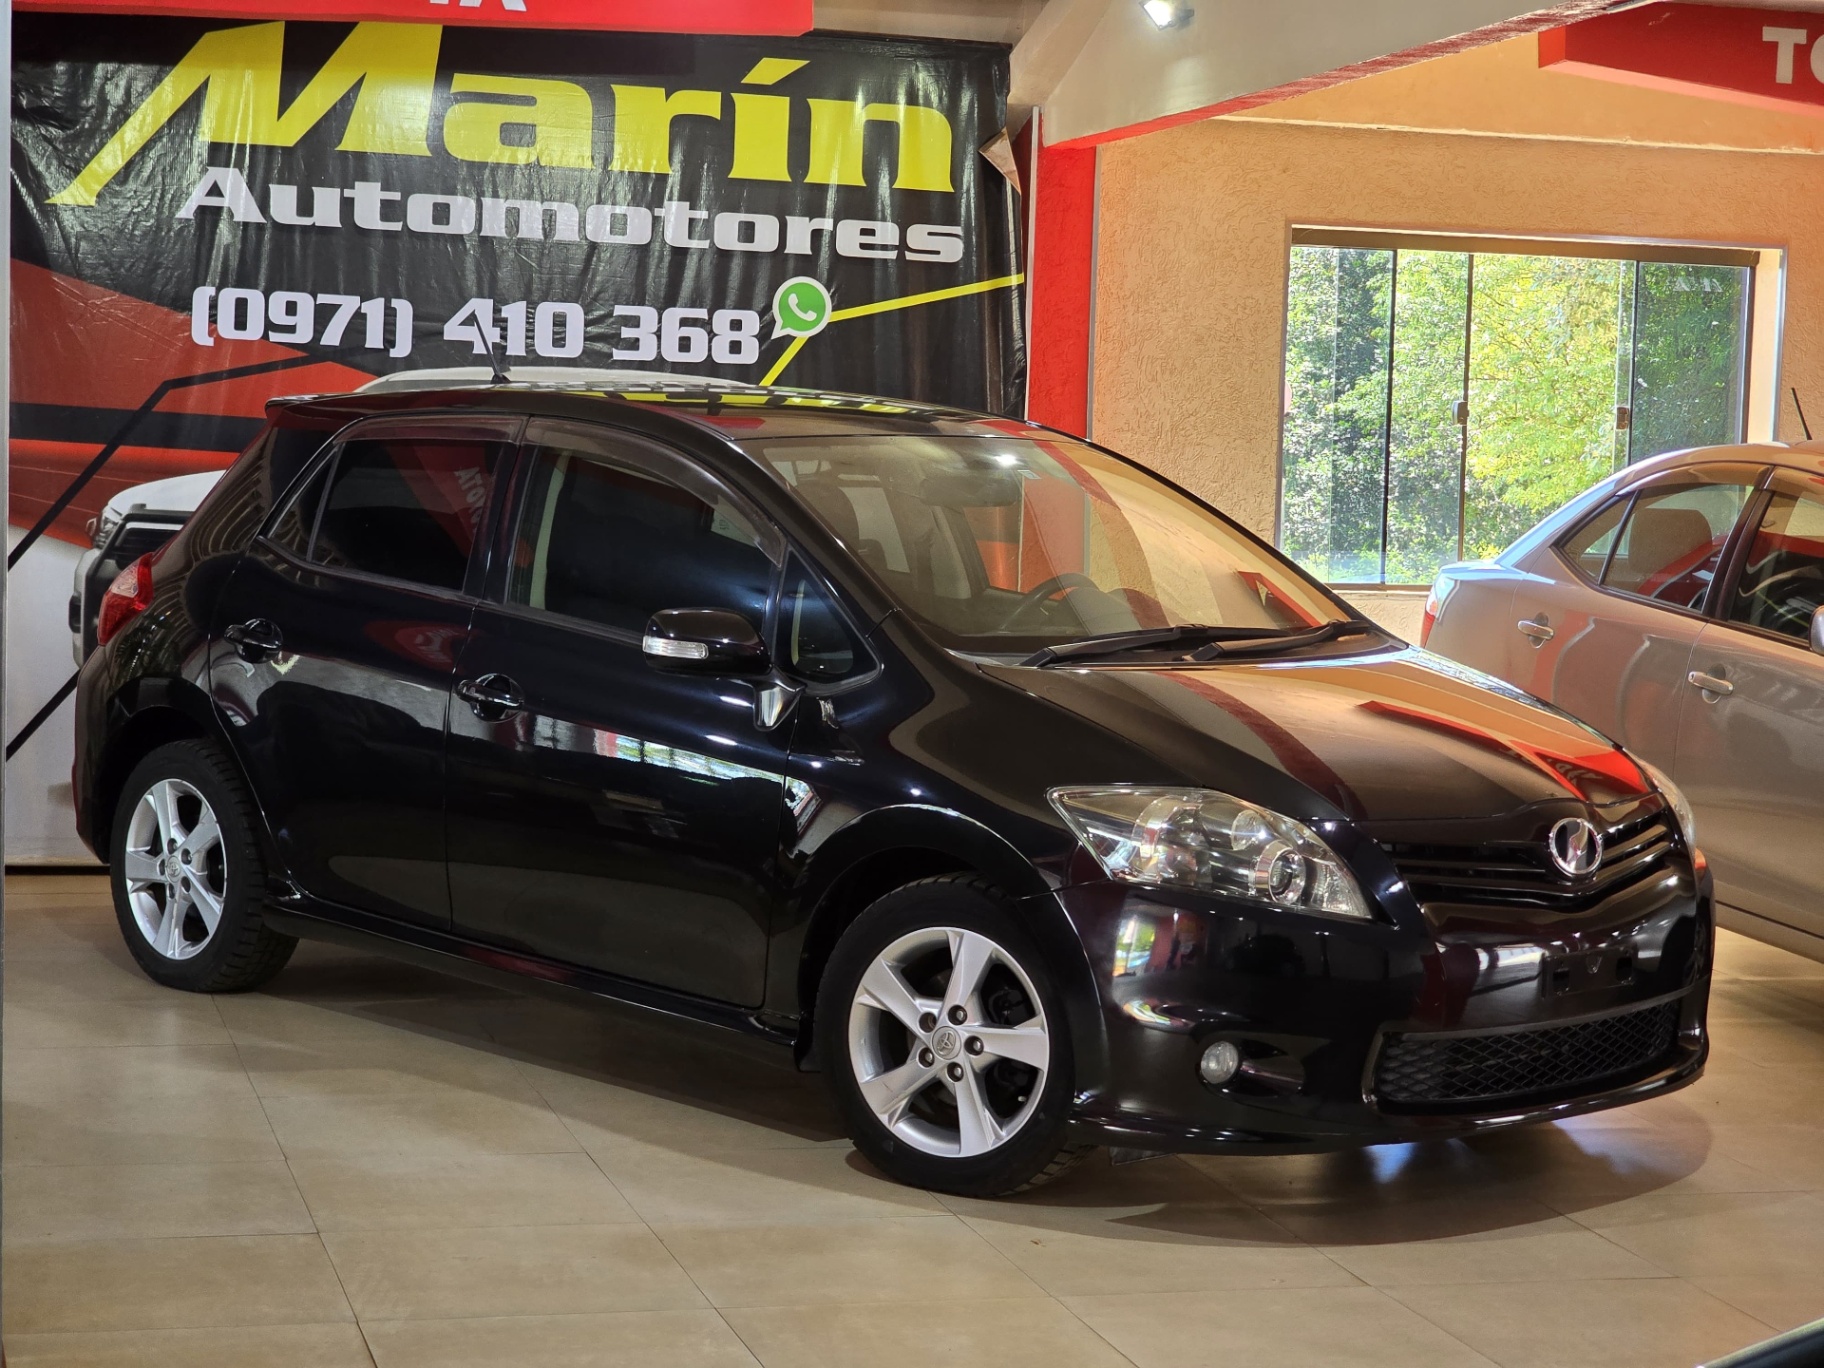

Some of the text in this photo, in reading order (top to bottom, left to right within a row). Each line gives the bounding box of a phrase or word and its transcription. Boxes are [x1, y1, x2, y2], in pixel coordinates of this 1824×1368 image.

[45, 20, 954, 205] Marín
[175, 166, 963, 263] Automotores
[191, 286, 760, 365] (0971) 410 368
